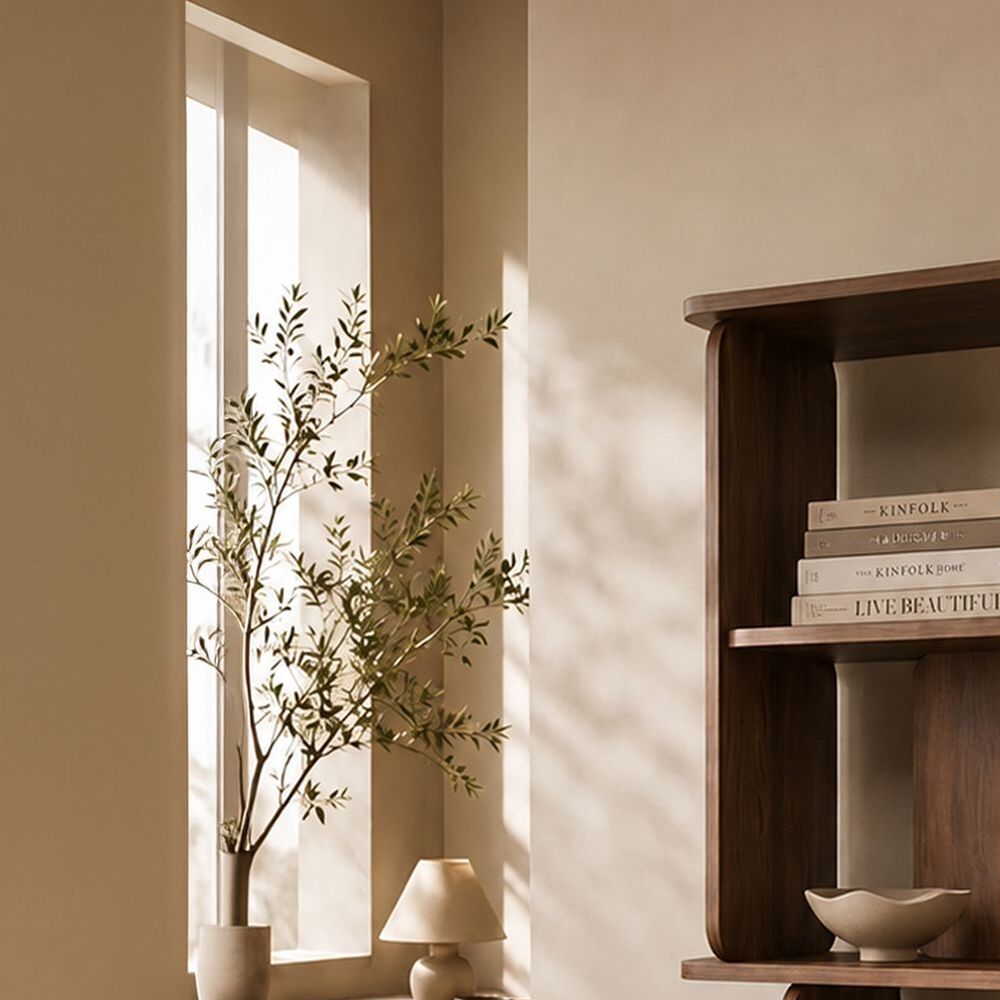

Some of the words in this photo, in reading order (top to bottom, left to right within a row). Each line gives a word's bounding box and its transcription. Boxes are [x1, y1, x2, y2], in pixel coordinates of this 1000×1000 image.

[879, 501, 950, 517] KINFOLK
[875, 564, 934, 578] KINFOLK
[855, 597, 898, 617] LIVE
